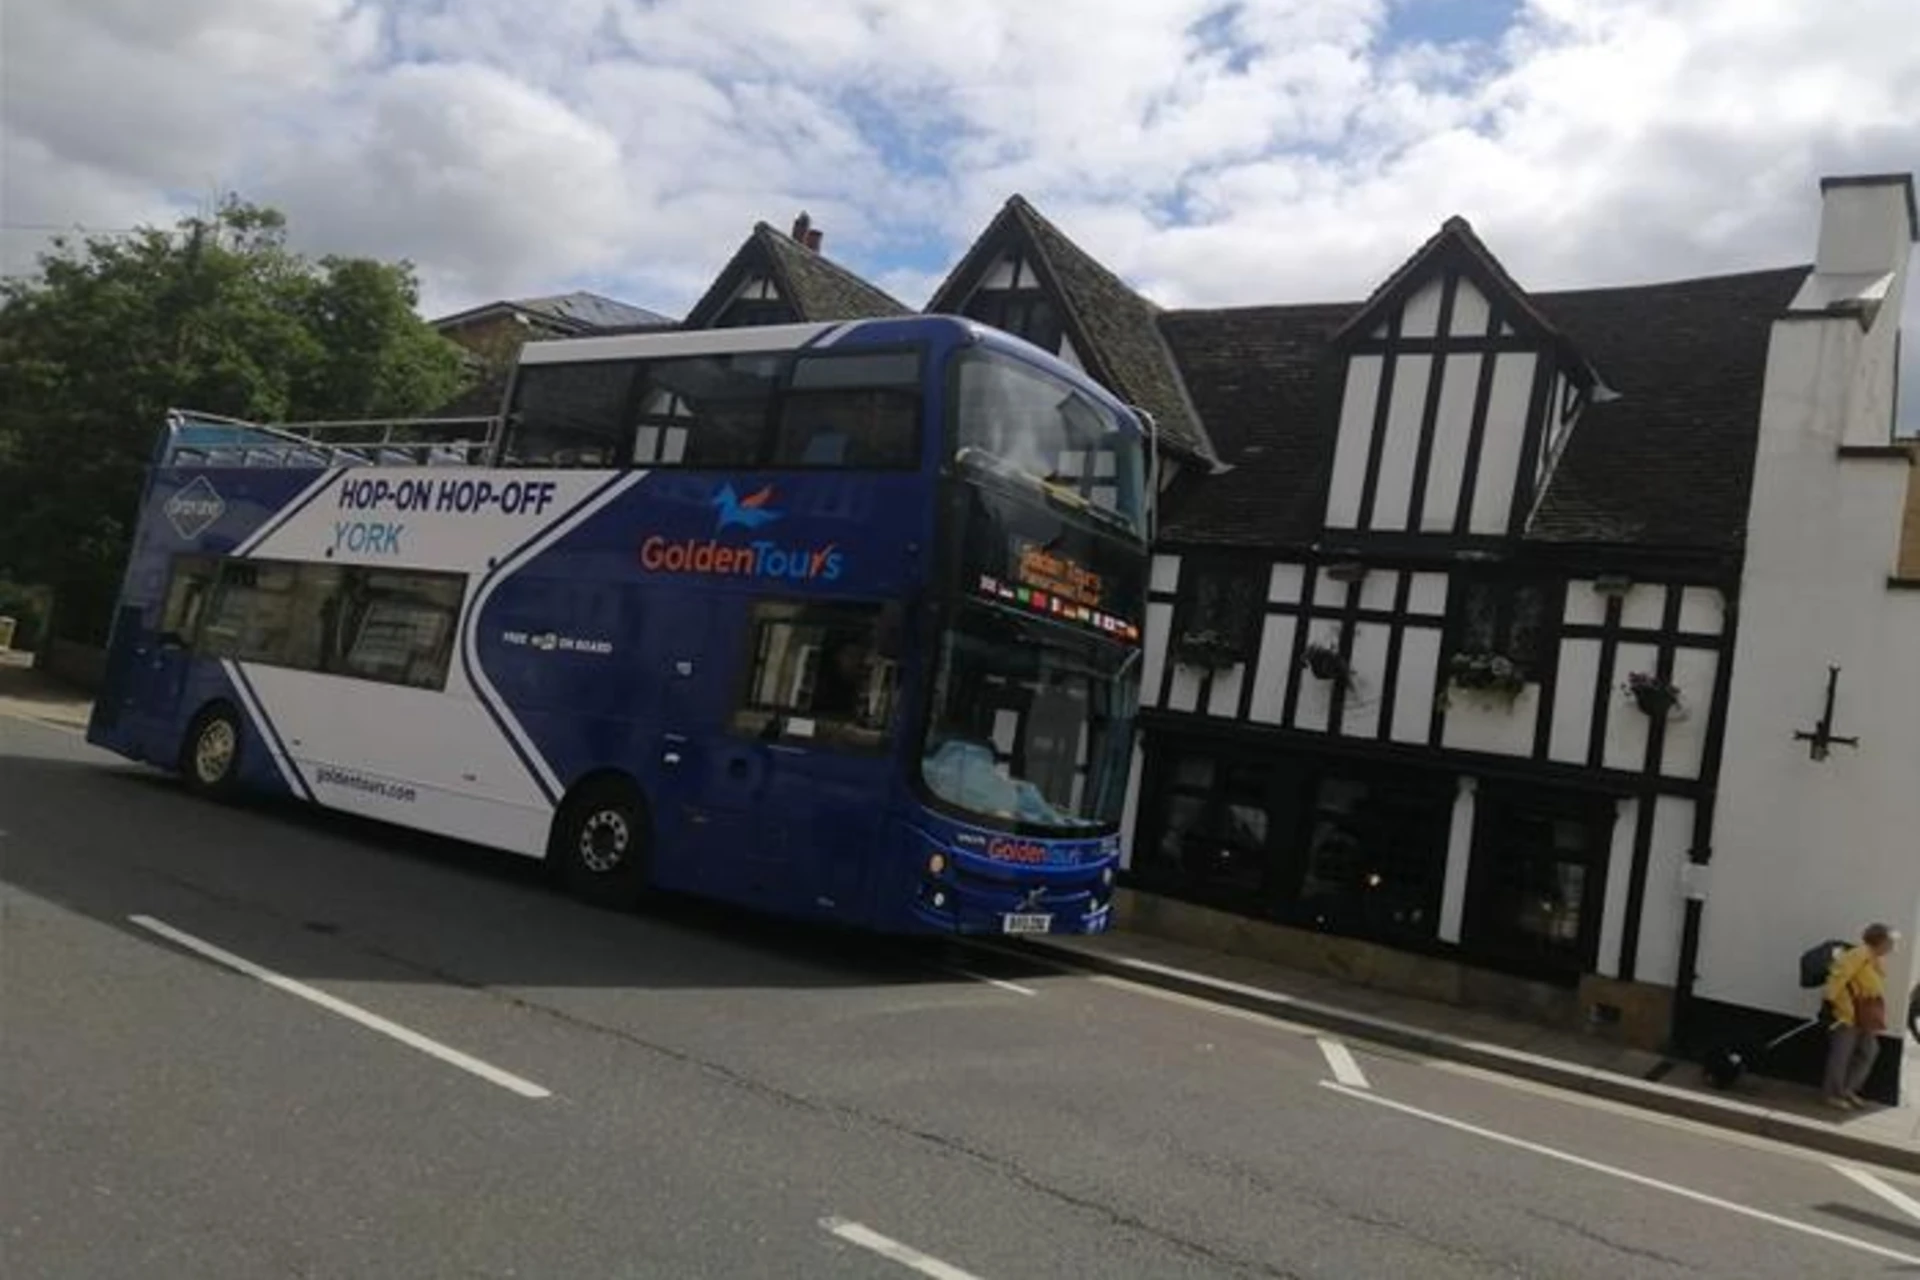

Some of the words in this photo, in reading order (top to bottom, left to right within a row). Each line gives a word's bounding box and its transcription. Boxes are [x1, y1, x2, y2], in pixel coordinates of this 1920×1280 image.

[339, 479, 434, 513] HOP-ON
[438, 480, 557, 516] HOP-OFF
[333, 521, 405, 555] YORK
